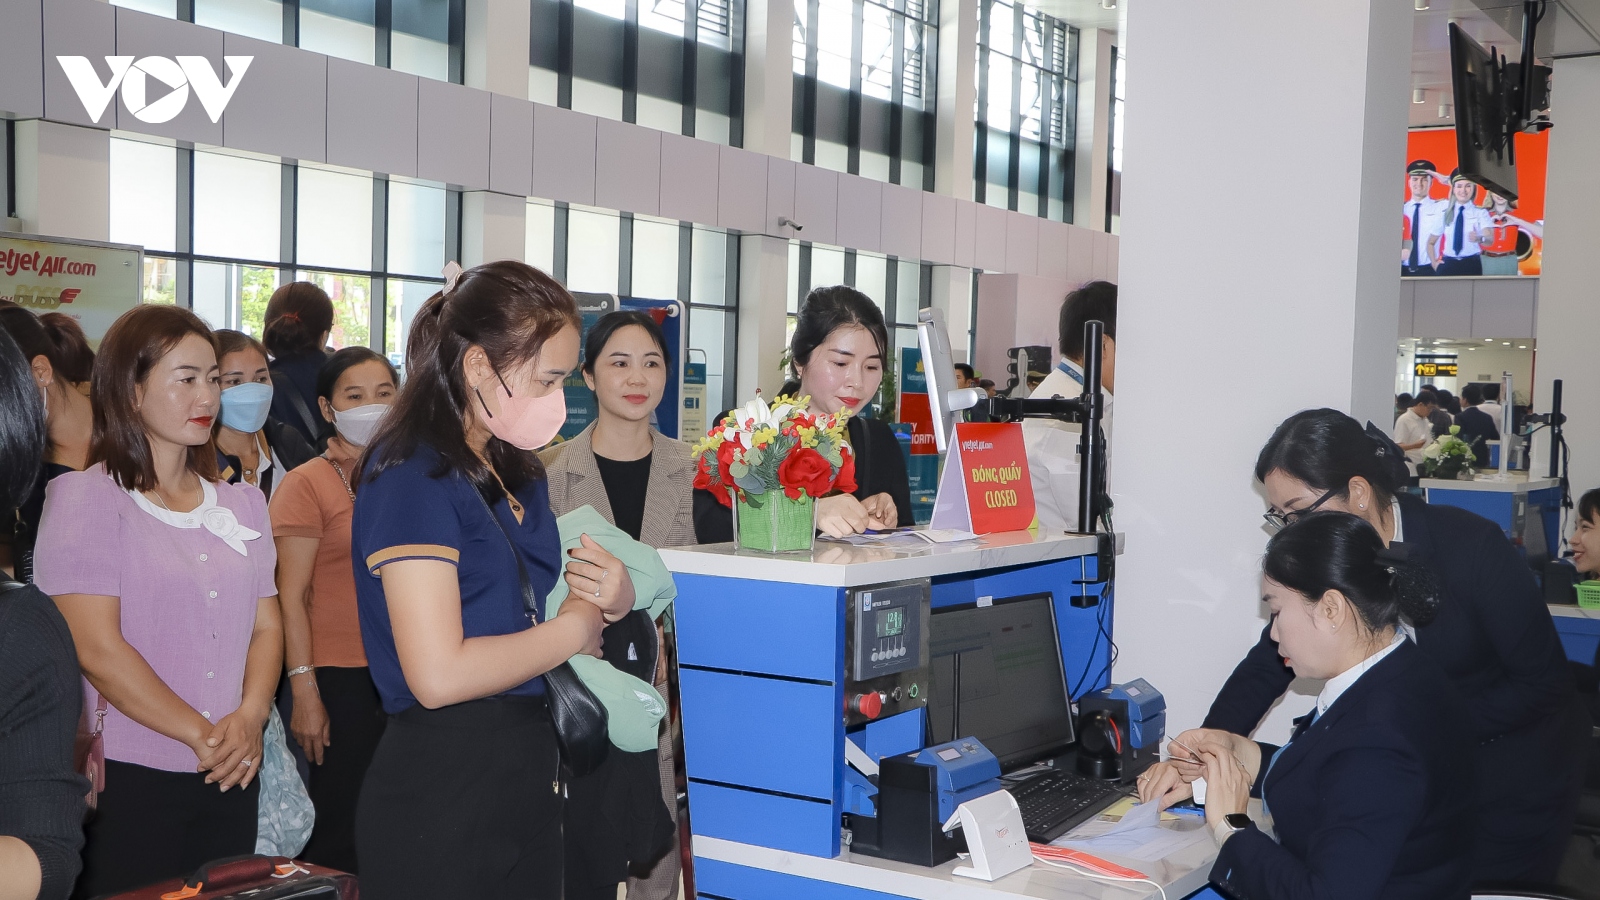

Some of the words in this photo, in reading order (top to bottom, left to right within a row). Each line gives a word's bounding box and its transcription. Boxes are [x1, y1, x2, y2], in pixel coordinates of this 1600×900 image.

[911, 433, 935, 445] IORITY
[972, 464, 998, 483] ĐÓNG
[985, 489, 1017, 508] CLOSED
